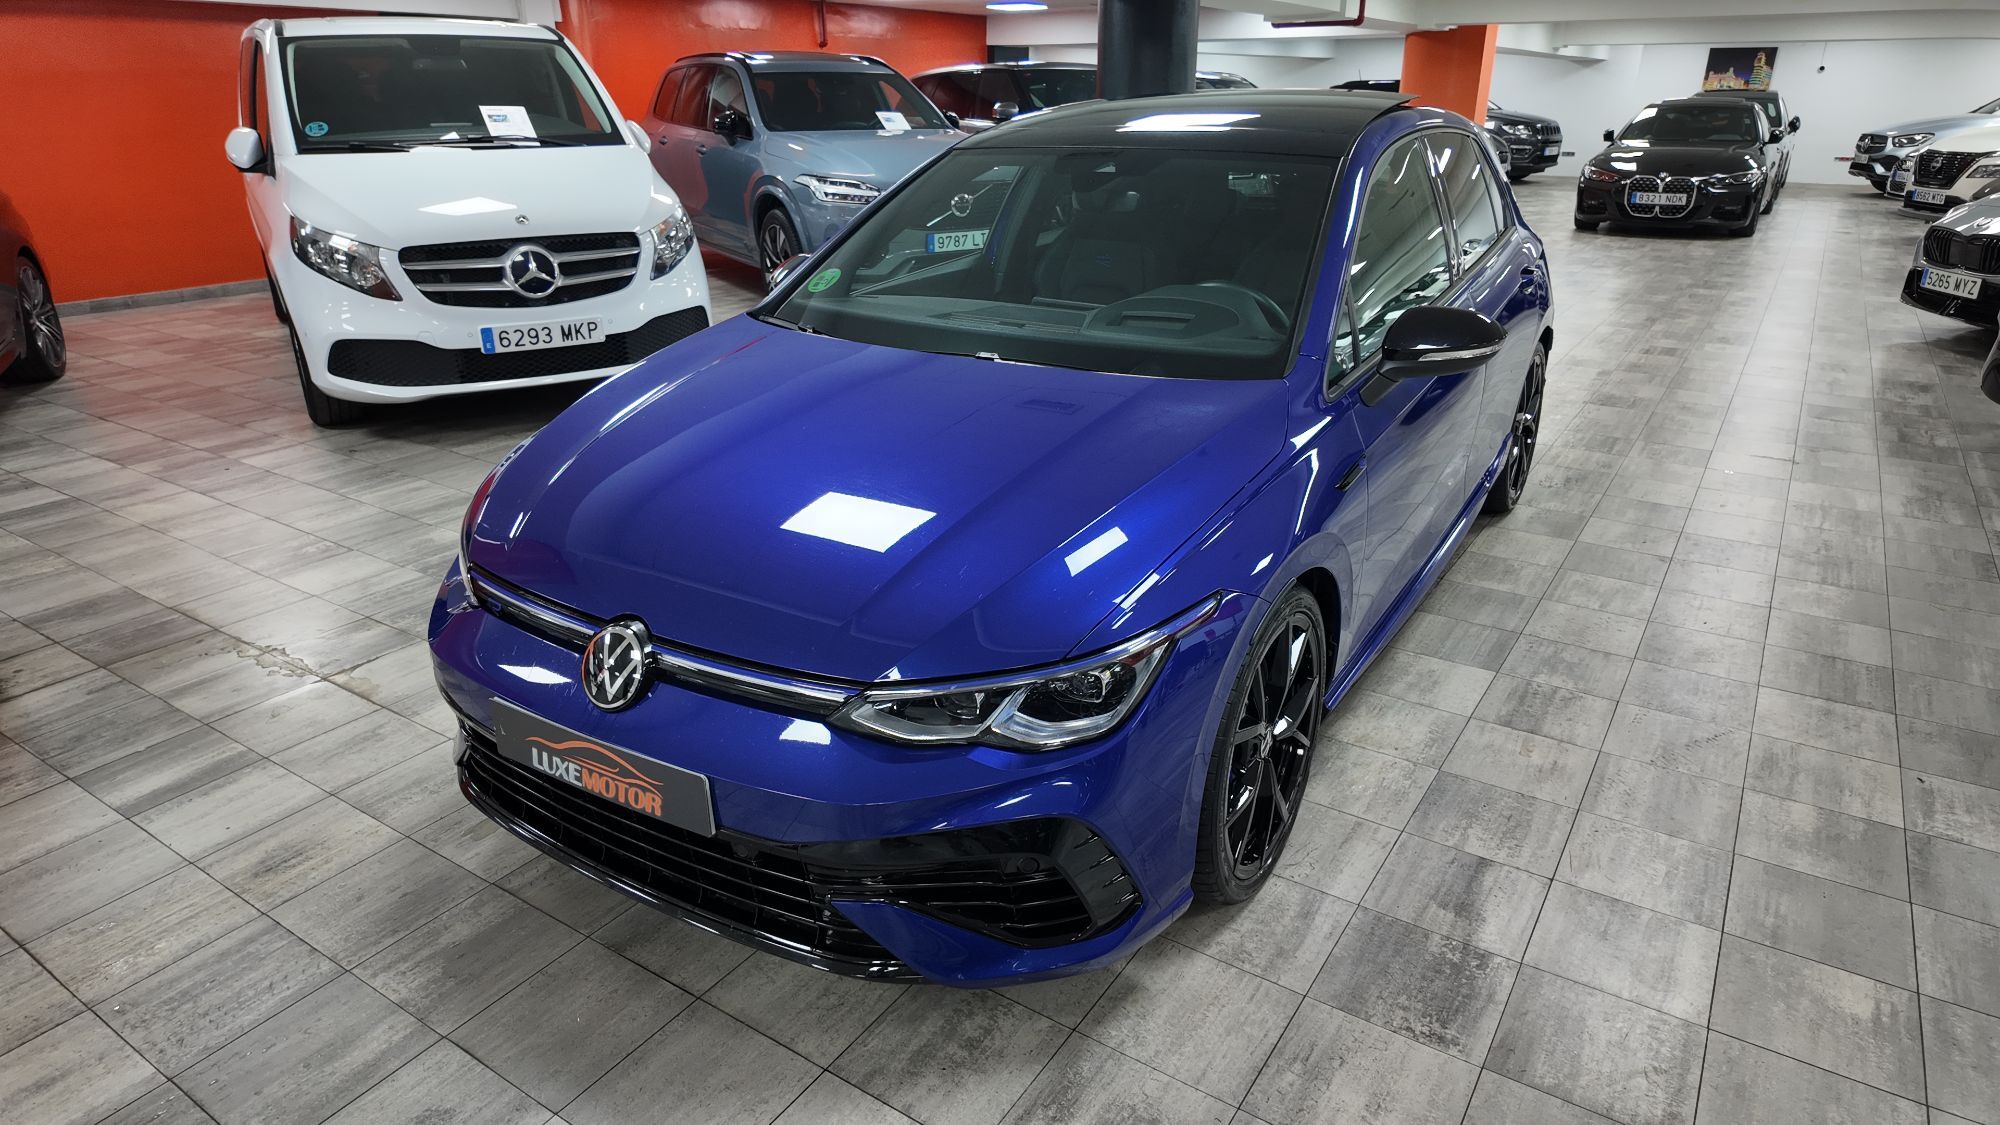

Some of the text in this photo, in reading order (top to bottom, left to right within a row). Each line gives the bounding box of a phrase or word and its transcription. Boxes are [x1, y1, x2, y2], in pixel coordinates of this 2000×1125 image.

[1638, 193, 1662, 203] 8321
[937, 232, 987, 249] 9787 LT
[1927, 271, 1978, 296] 5265 MYZ
[498, 321, 598, 348] 6293 MKP
[531, 746, 662, 817] LUXEMOTOR
